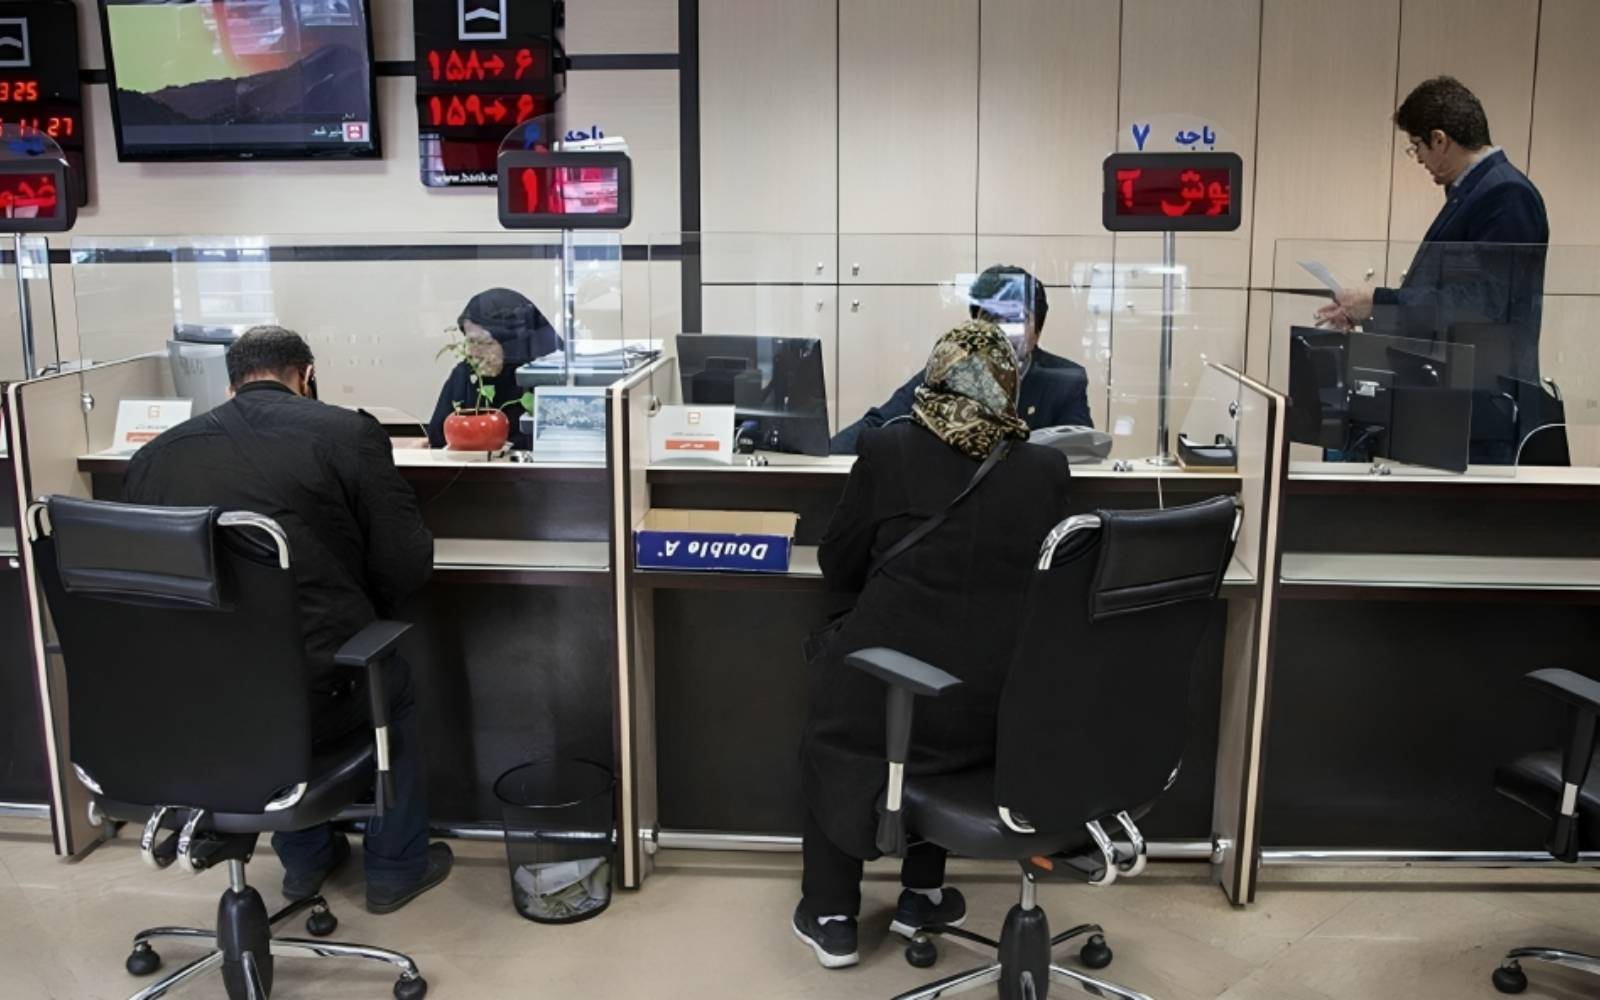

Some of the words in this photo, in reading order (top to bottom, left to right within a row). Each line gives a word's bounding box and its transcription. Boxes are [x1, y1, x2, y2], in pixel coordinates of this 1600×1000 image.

[515, 49, 533, 81] ۶
[1132, 124, 1150, 151] ۷
[1174, 126, 1217, 151] باجه
[664, 539, 680, 557] A
[687, 540, 769, 560] Double
